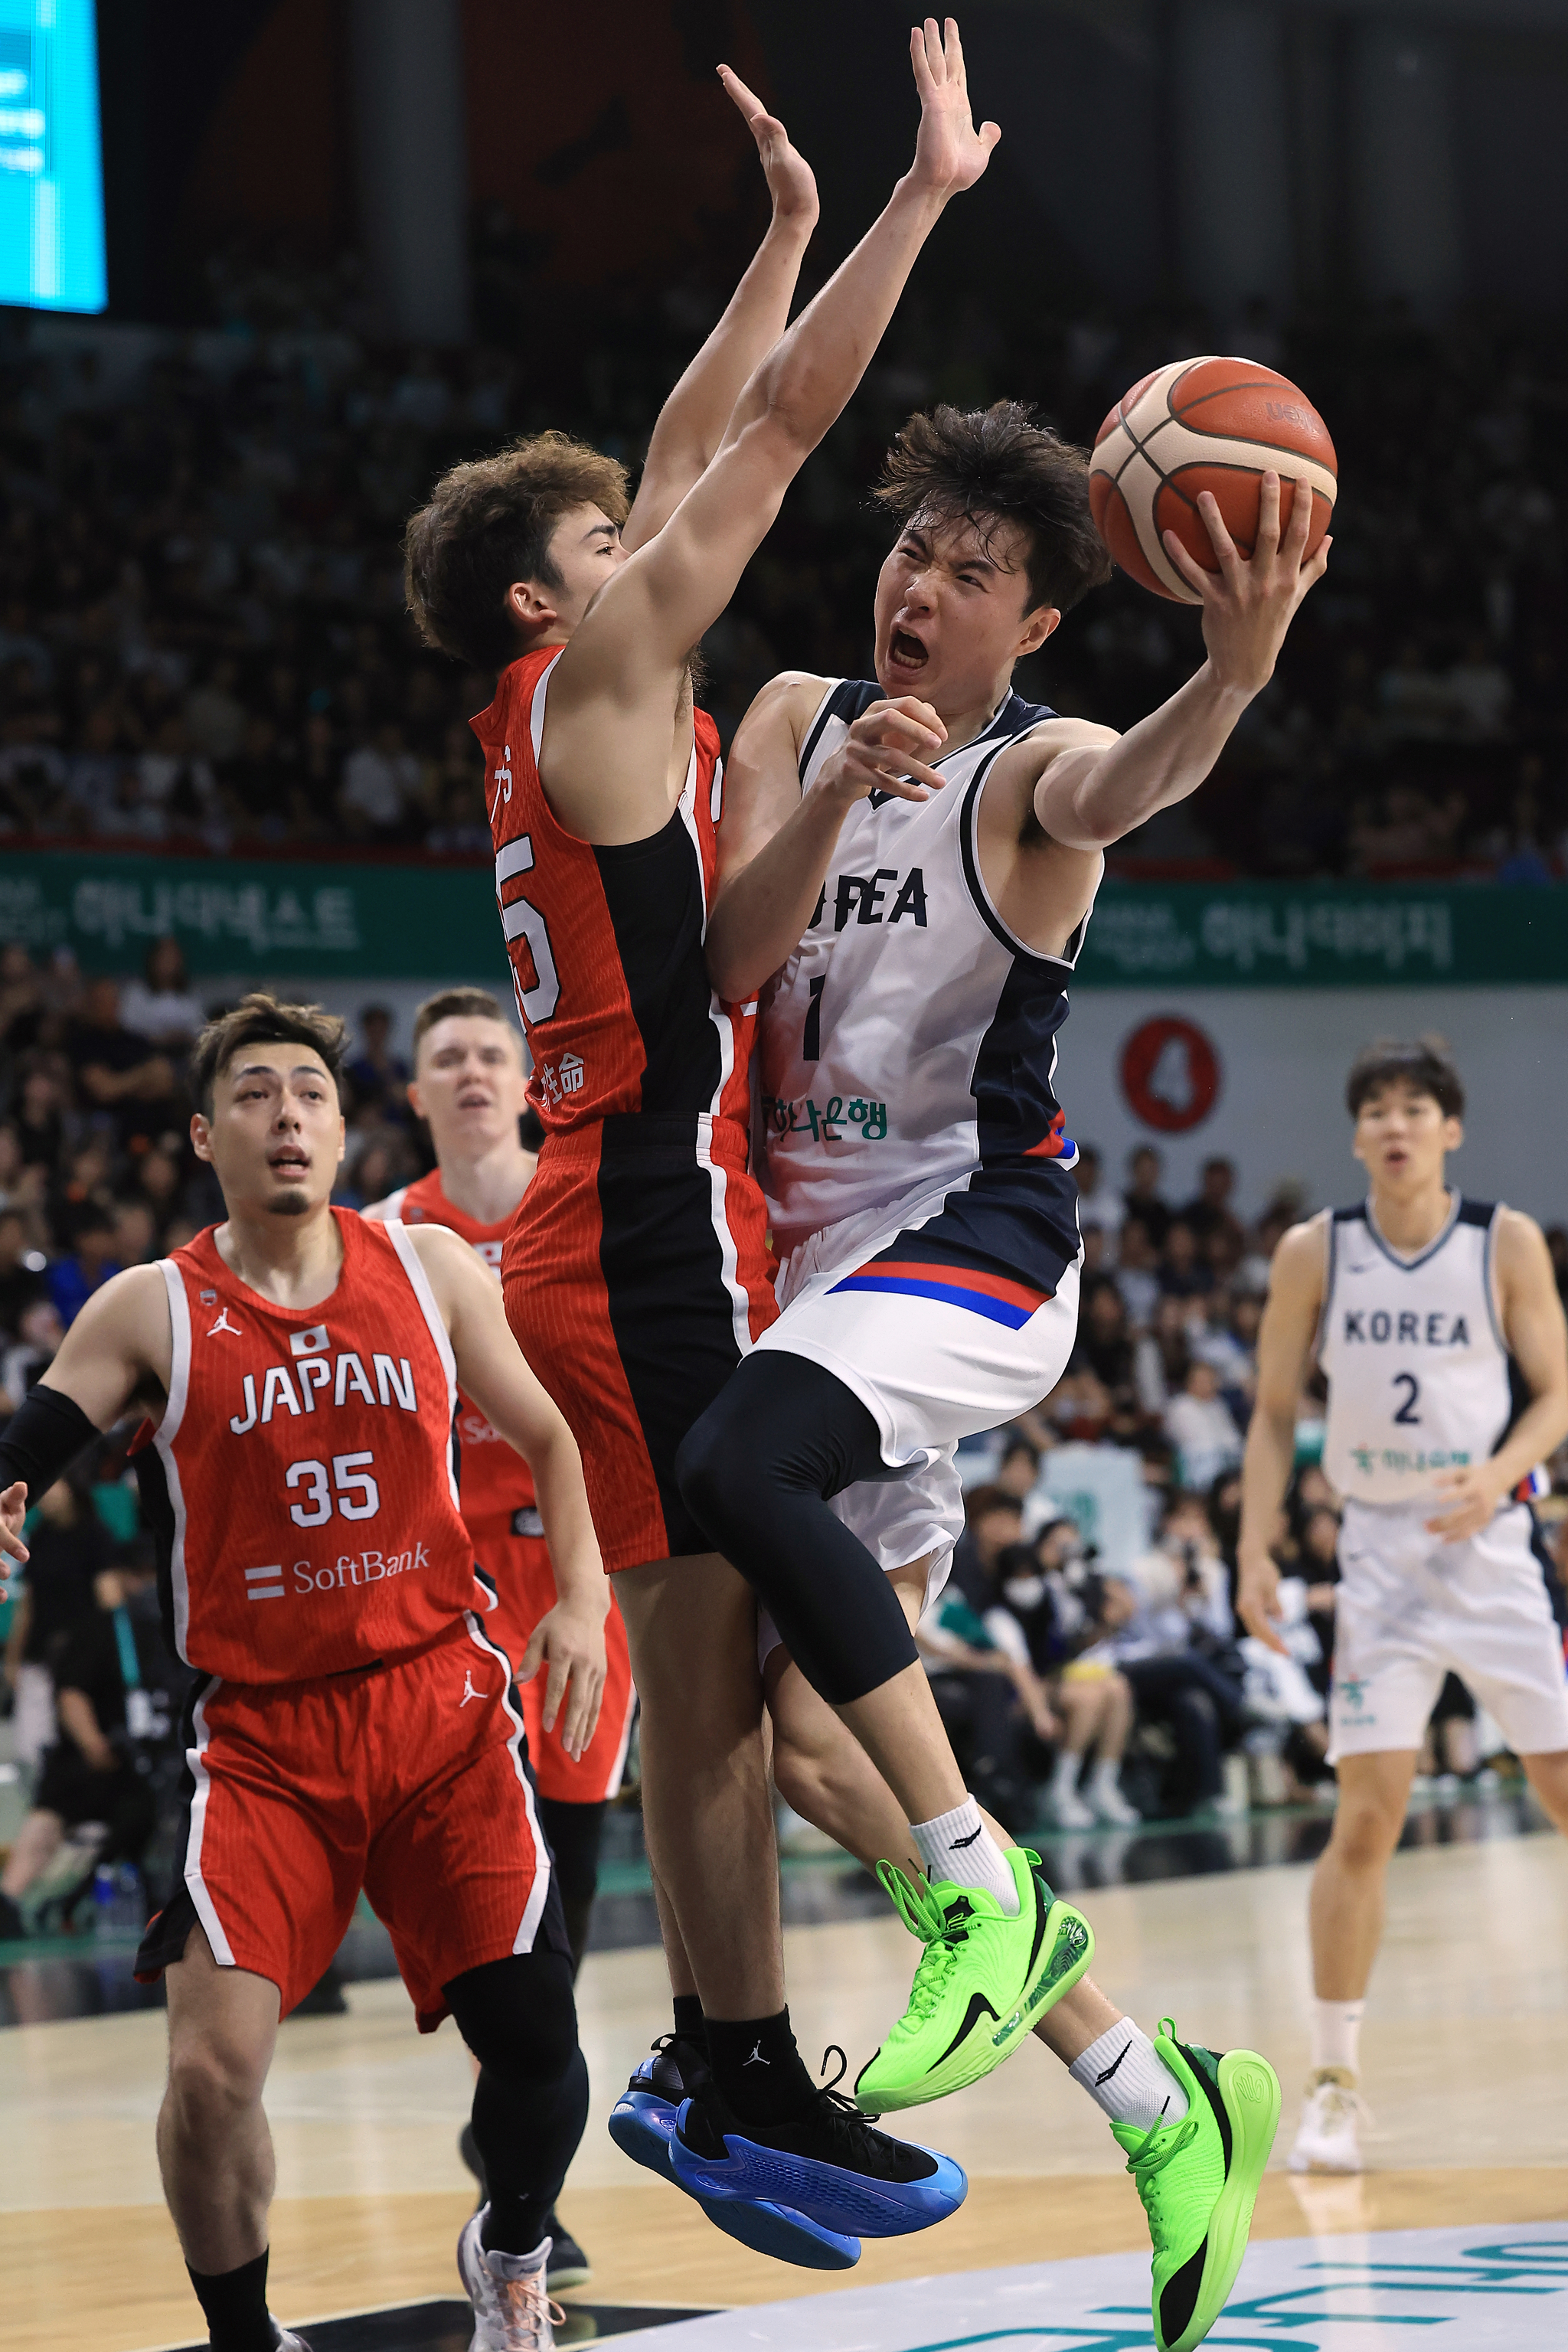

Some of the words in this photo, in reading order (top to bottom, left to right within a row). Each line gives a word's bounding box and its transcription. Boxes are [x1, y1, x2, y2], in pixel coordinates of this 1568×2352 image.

[494, 835, 560, 1034] 5
[806, 867, 929, 933] REA
[802, 973, 826, 1061] 1
[1344, 1310, 1469, 1346] KOREA
[230, 1352, 418, 1436] JAPAN
[1393, 1374, 1421, 1424] 2
[284, 1449, 381, 1528] 35
[292, 1542, 430, 1595] SoftBank
